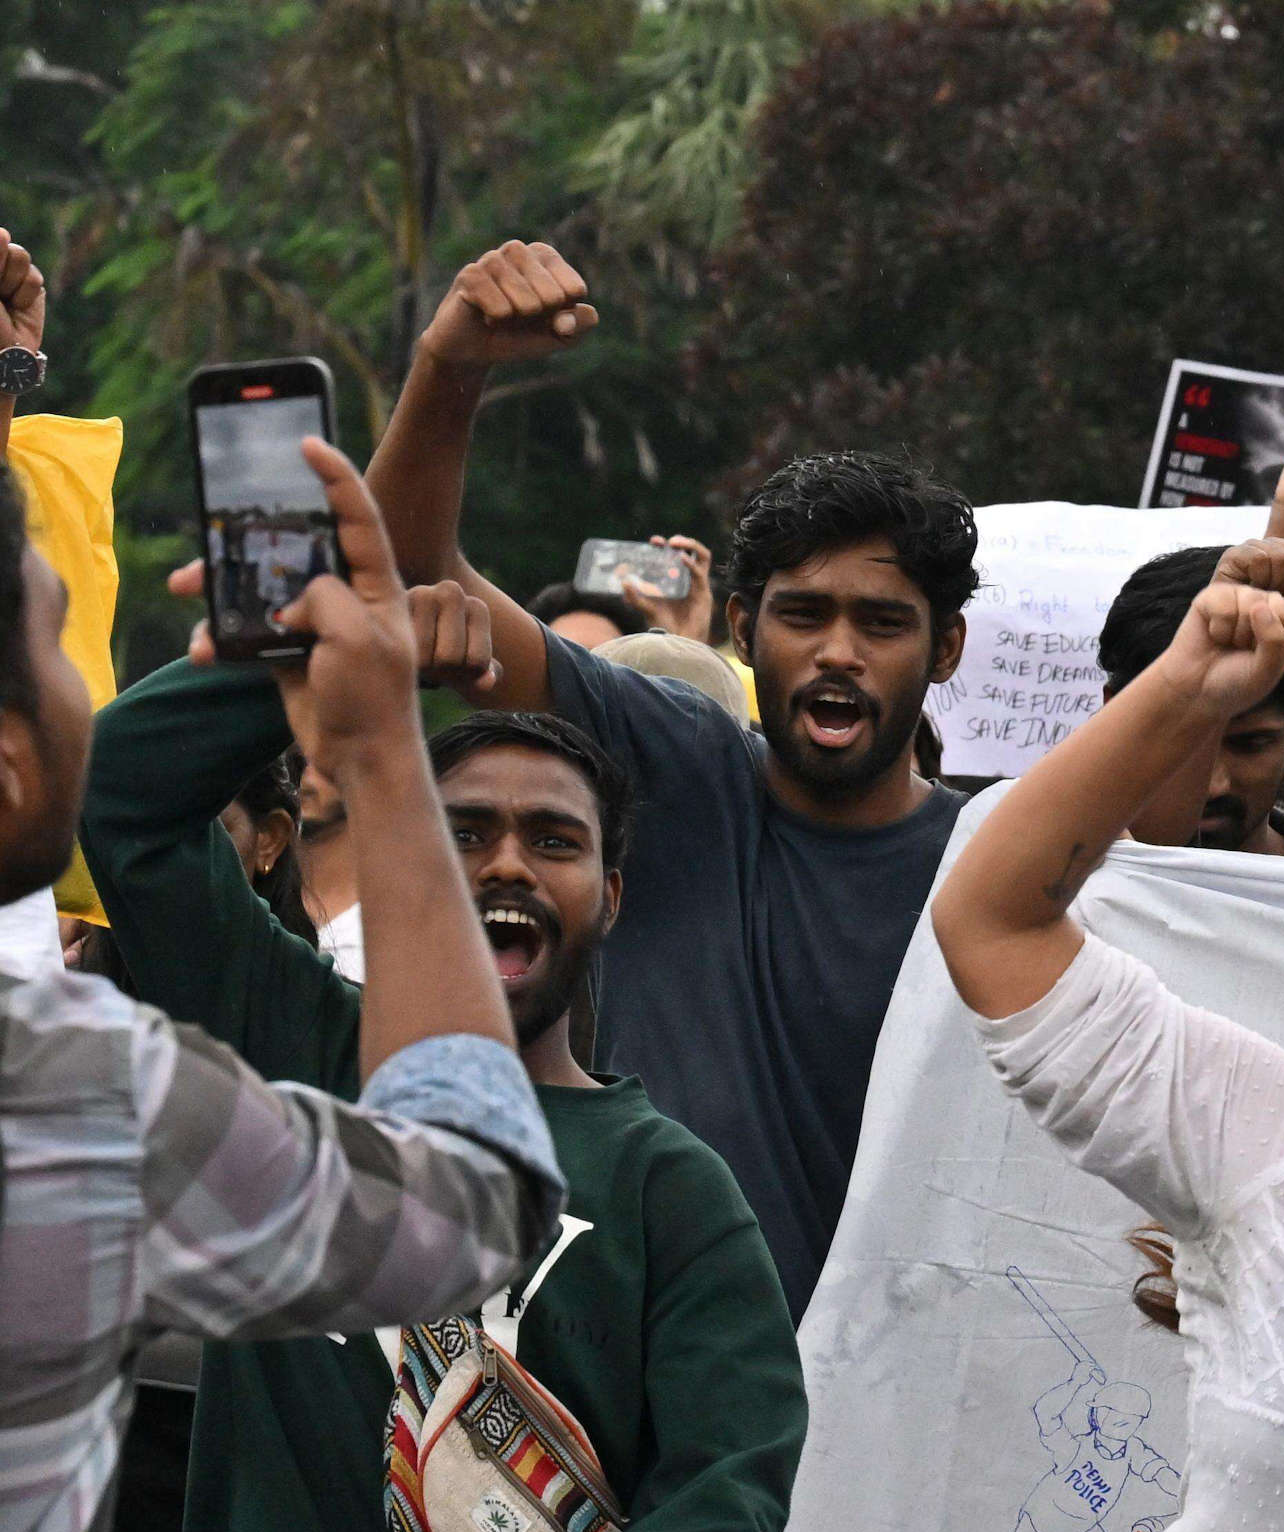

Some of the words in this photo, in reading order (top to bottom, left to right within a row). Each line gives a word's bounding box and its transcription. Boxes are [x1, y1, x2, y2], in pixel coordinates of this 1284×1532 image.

[995, 630, 1037, 651] SAVE
[1041, 632, 1101, 655] EDUCA
[991, 656, 1031, 677] SAVE
[977, 683, 1026, 710] SAVE
[961, 717, 1018, 742] SAVE
[1064, 1469, 1107, 1513] POLICE
